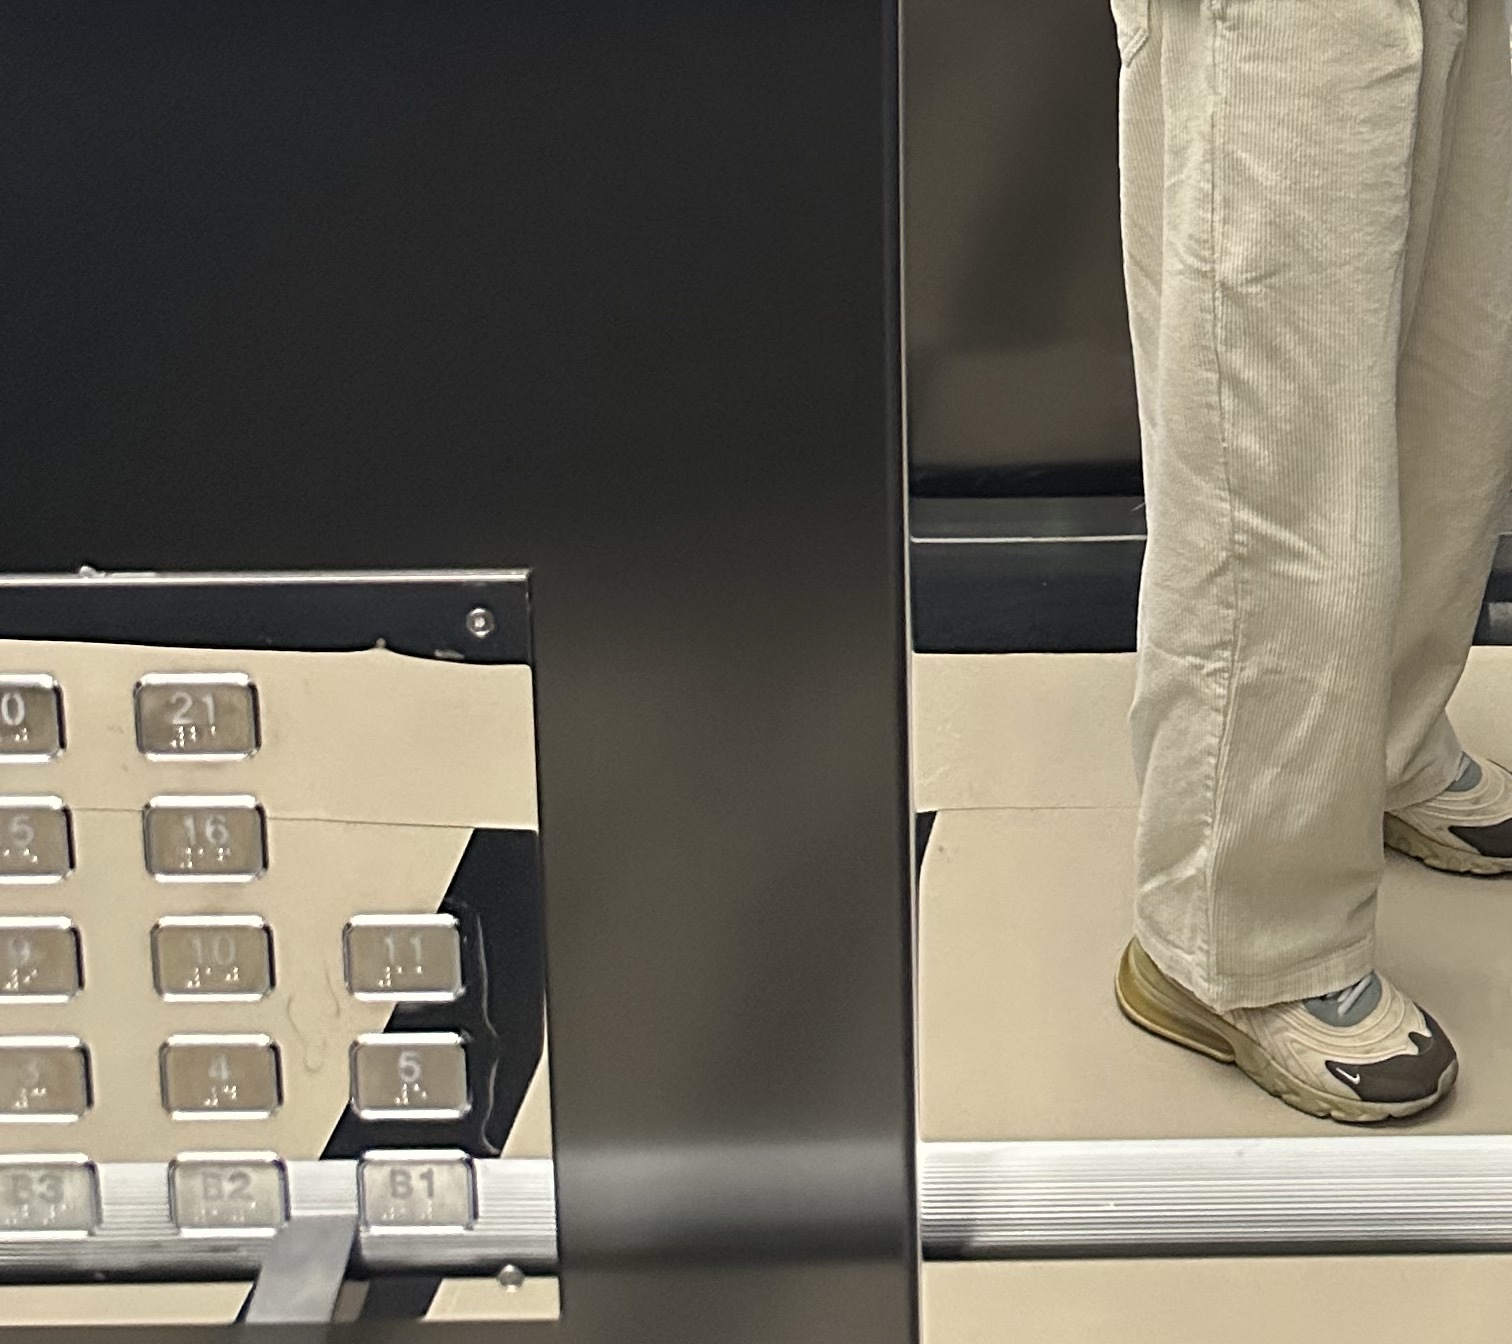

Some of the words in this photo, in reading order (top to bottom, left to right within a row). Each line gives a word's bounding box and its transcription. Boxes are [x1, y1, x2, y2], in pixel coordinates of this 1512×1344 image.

[170, 691, 216, 725] 21
[183, 814, 229, 846] 16
[191, 934, 236, 965] 10
[385, 935, 422, 964] 11
[203, 1171, 252, 1201] B2
[390, 1167, 435, 1199] B1
